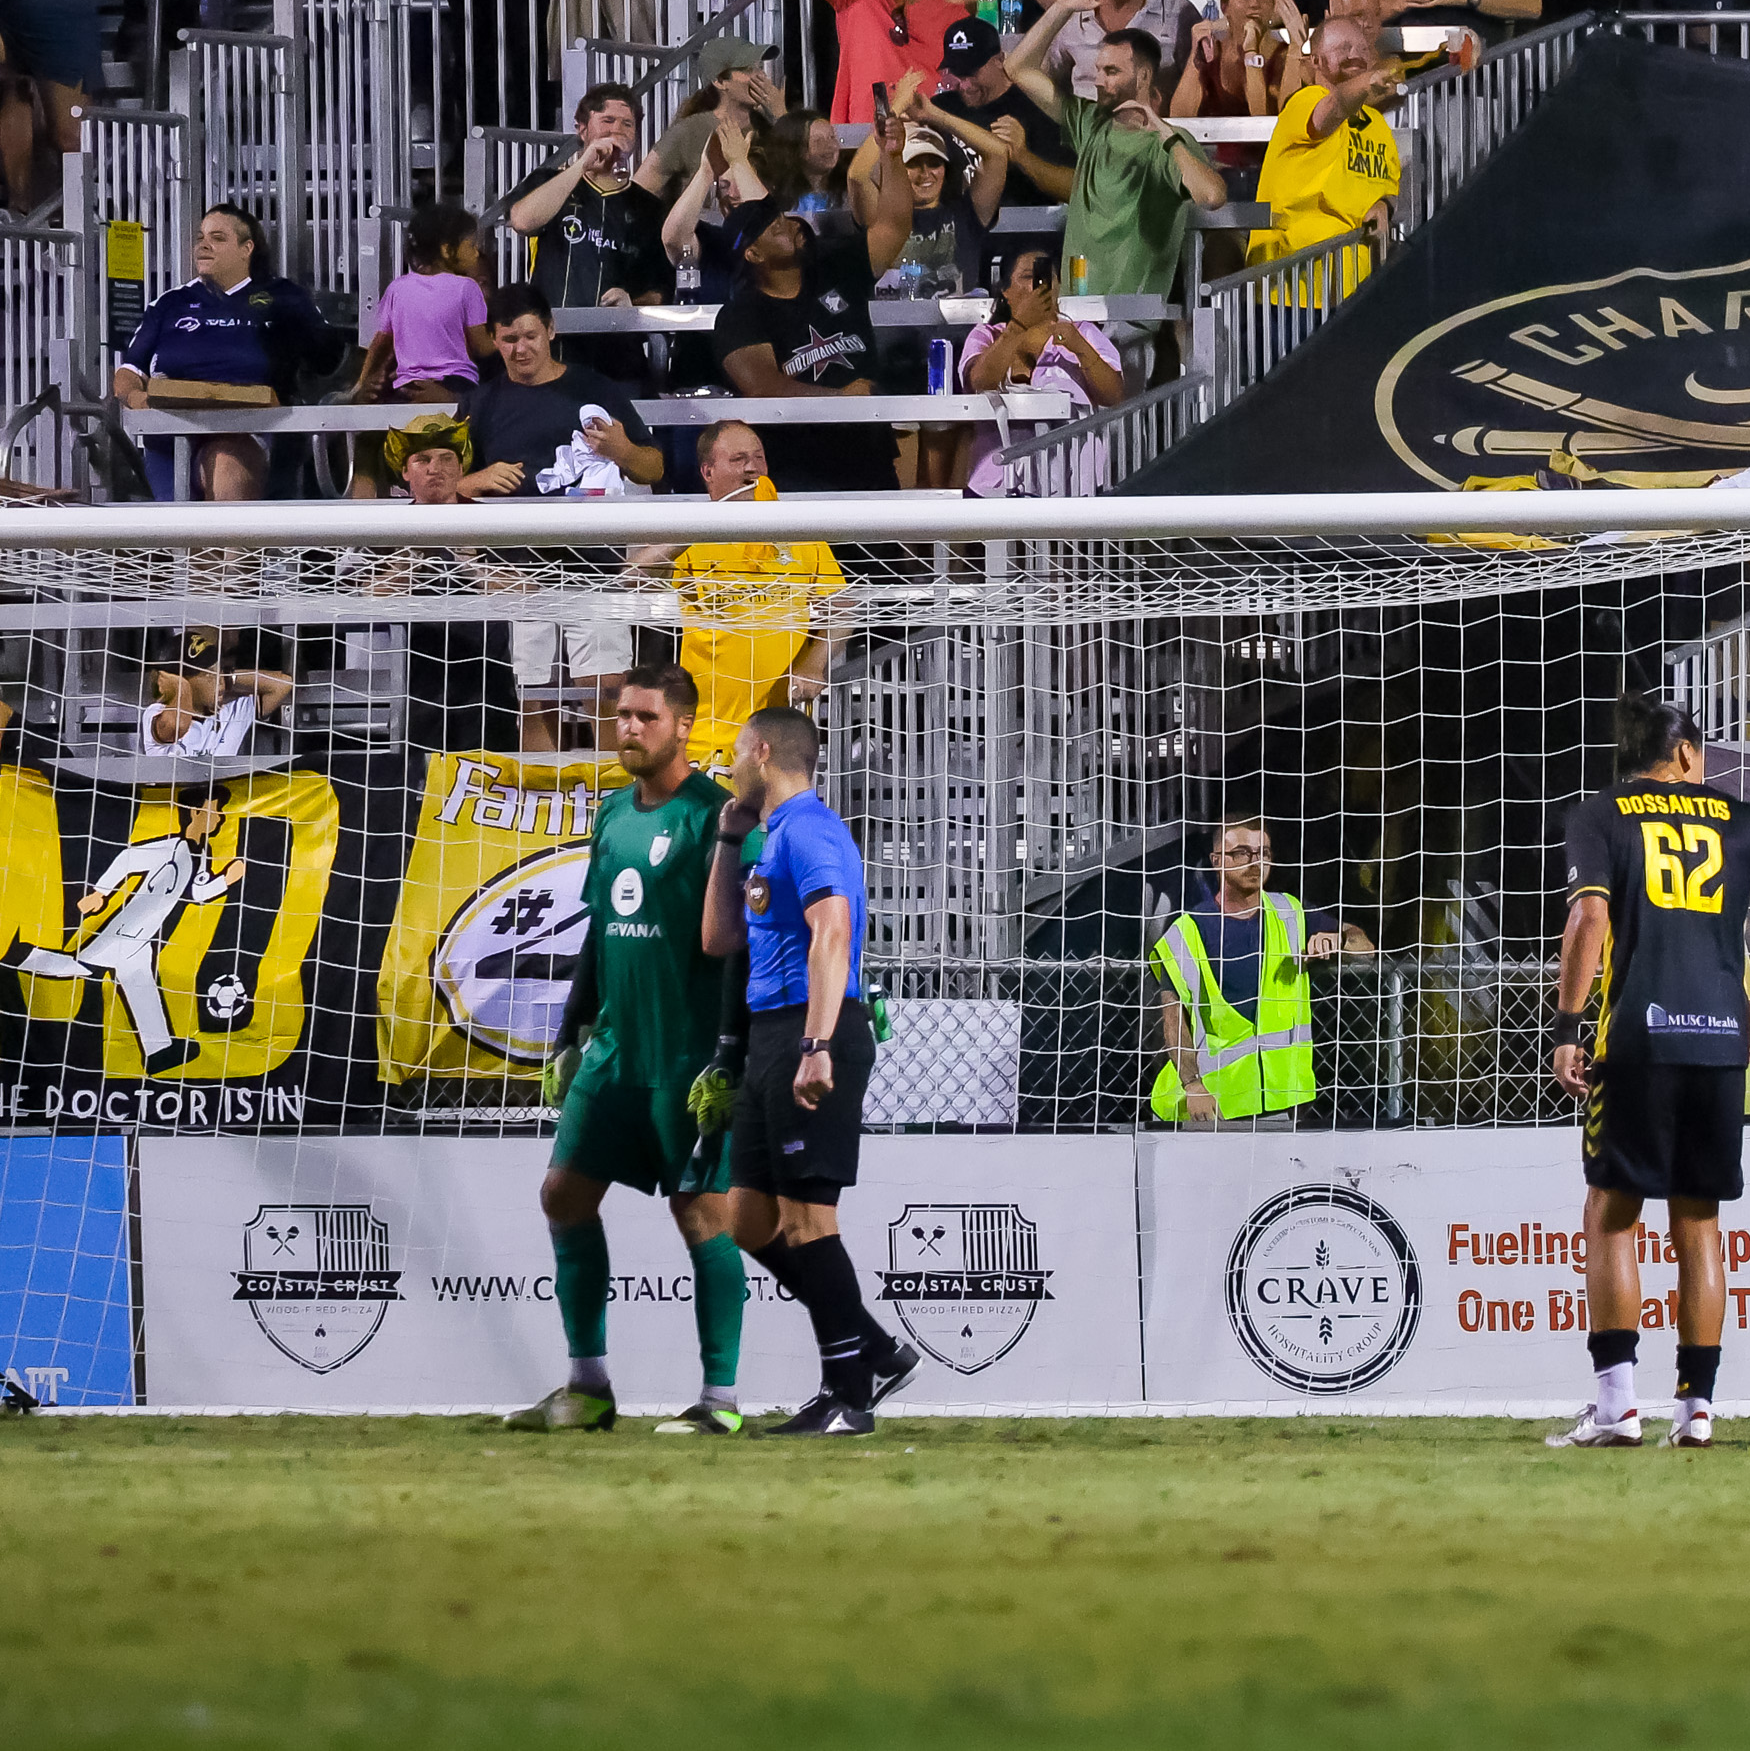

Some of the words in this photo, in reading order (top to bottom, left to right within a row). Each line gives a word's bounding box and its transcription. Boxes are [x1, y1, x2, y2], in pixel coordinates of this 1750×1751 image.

[1616, 794, 1731, 821] DOSSANTOS
[1641, 820, 1729, 914] 62
[1669, 1014, 1706, 1027] MUSC
[1708, 1014, 1739, 1029] Health
[46, 1086, 208, 1126] DOCTOR
[224, 1087, 255, 1124] IS
[266, 1085, 303, 1124] IN
[1449, 1224, 1588, 1274] Fueling
[247, 1279, 324, 1294] COASTAL
[333, 1278, 390, 1294] CRUST
[891, 1278, 972, 1293] COASTAL
[980, 1278, 1039, 1293] CRUST
[1257, 1277, 1389, 1309] CRAVE
[989, 1305, 1022, 1316] PIZZA
[1459, 1291, 1535, 1332] One
[1267, 1323, 1346, 1365] HOSPITALITY
[1347, 1321, 1385, 1358] GROUP
